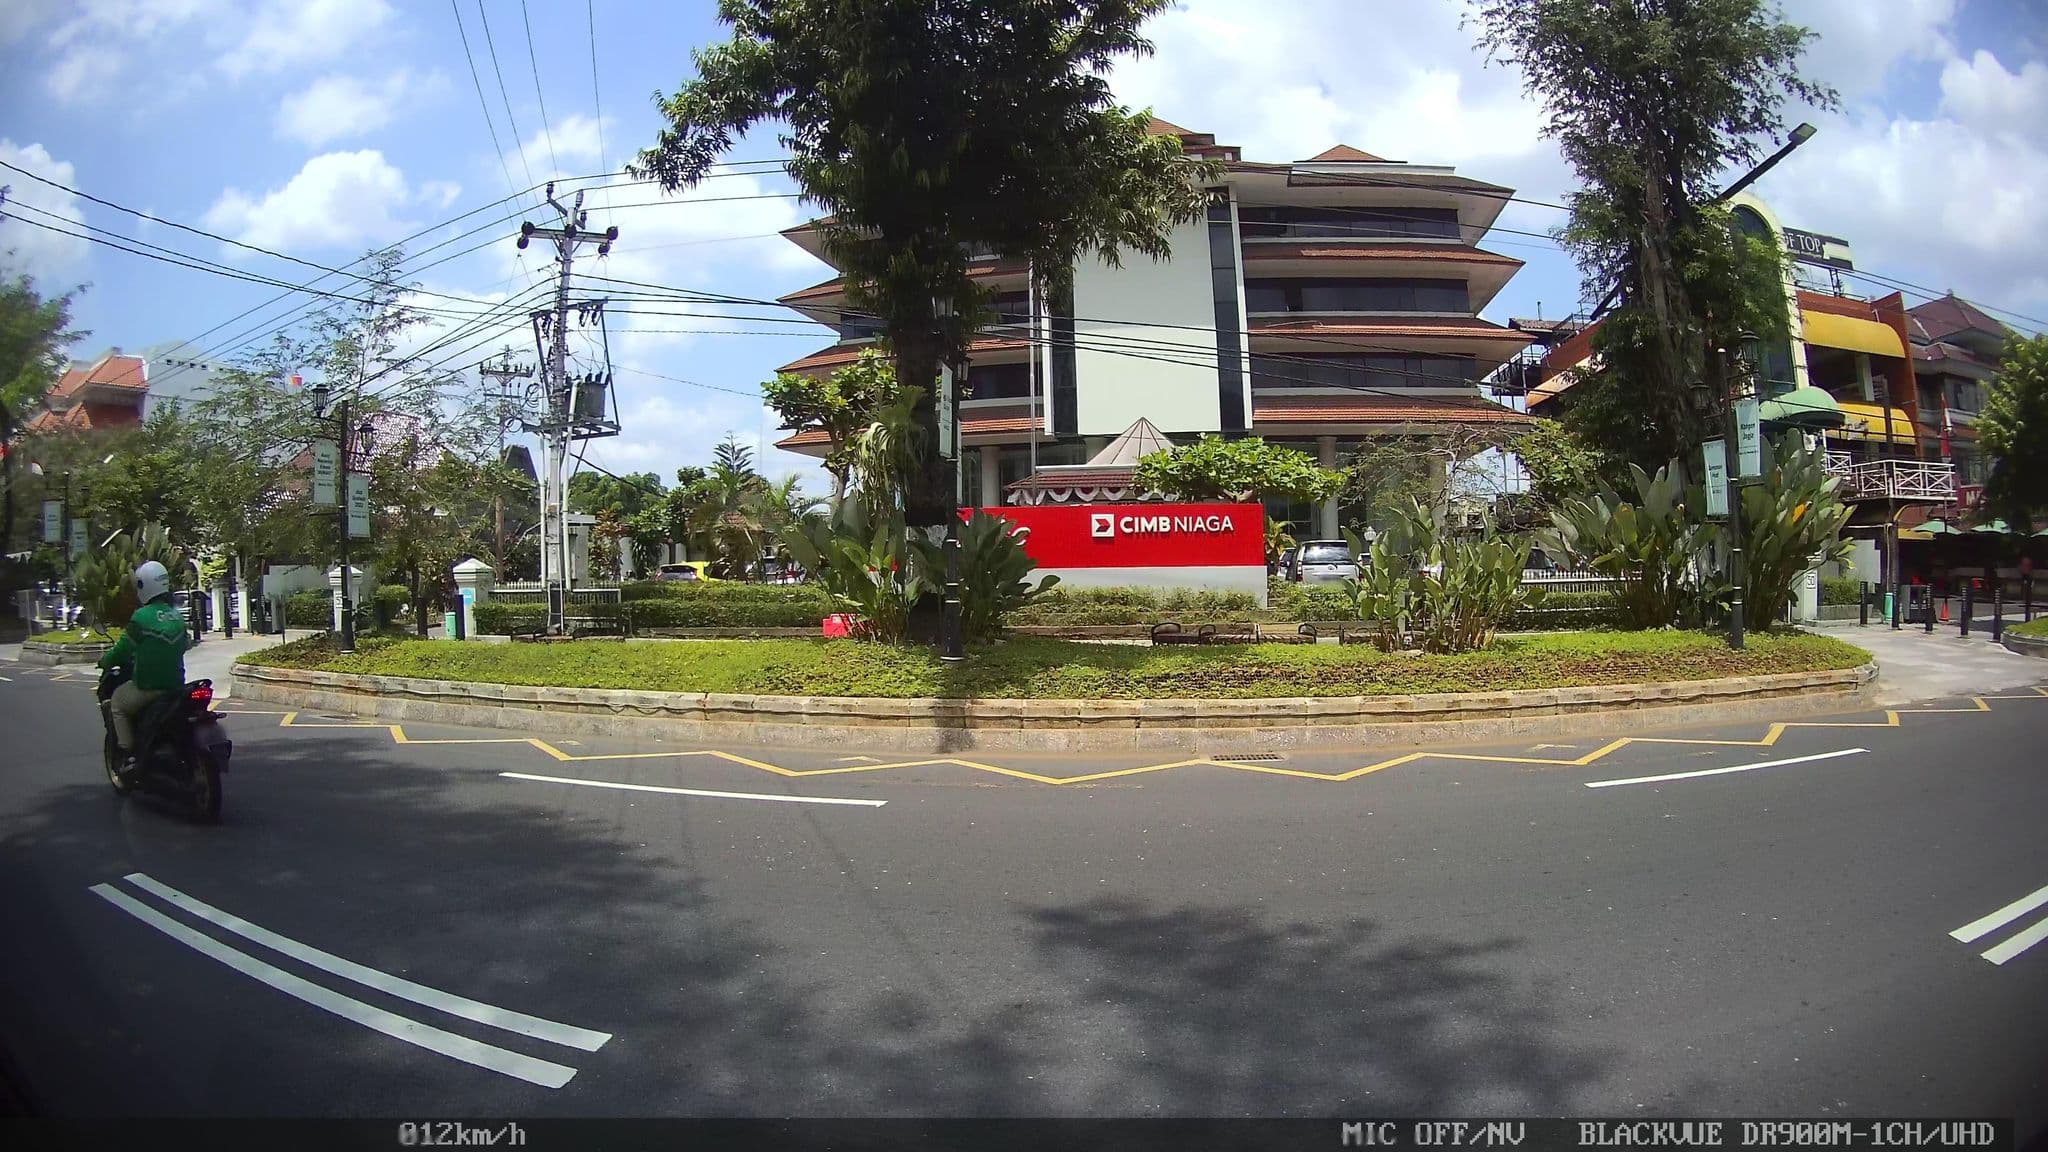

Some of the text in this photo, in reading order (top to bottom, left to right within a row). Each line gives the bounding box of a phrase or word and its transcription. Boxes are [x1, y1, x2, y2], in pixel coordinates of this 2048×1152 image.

[1796, 234, 1821, 253] TOP
[1119, 515, 1235, 533] CIMB NIAGA
